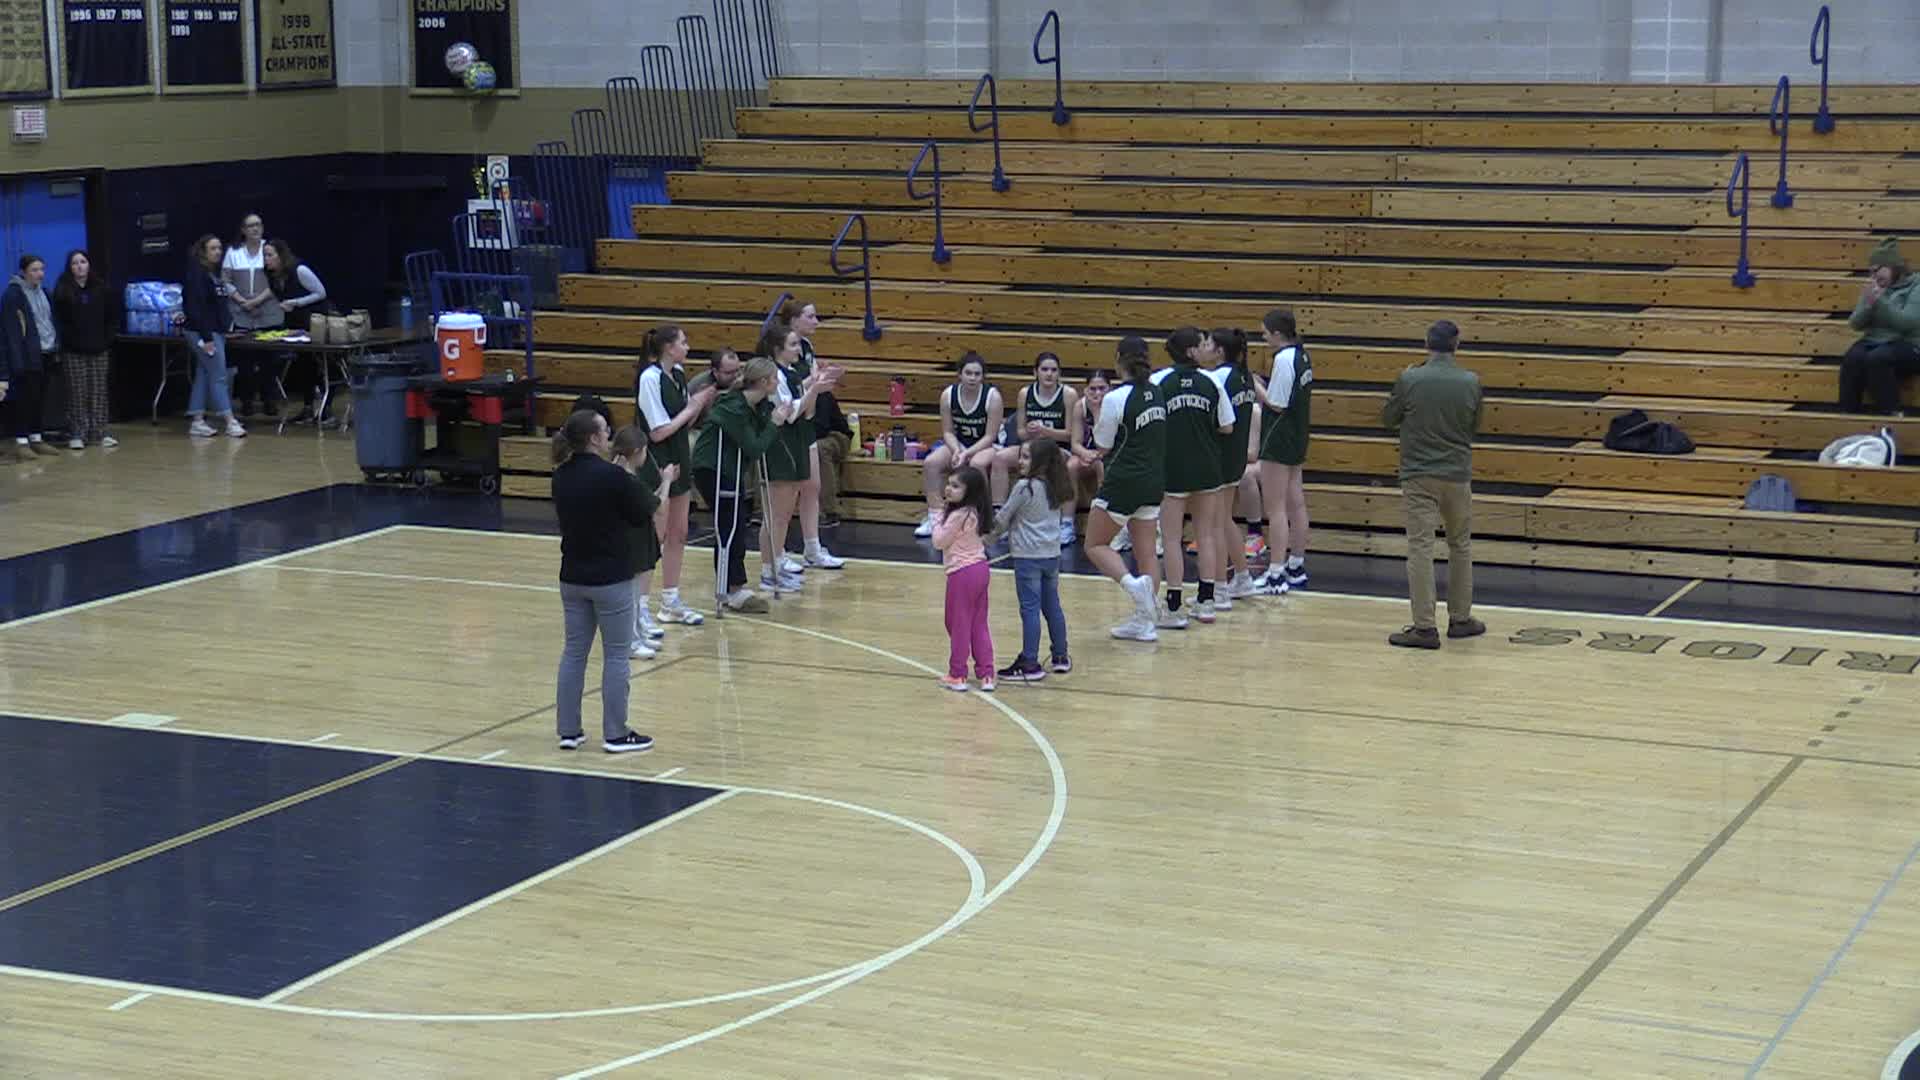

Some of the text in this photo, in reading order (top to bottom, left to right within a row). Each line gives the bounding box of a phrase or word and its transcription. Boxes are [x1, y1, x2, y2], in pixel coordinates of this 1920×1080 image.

[281, 15, 311, 29] 1998
[418, 17, 446, 28] 2006
[271, 34, 328, 50] ALL-STATE
[265, 55, 329, 72] CHAMPIONS
[443, 339, 461, 360] G
[1166, 394, 1211, 414] PENTUCKET
